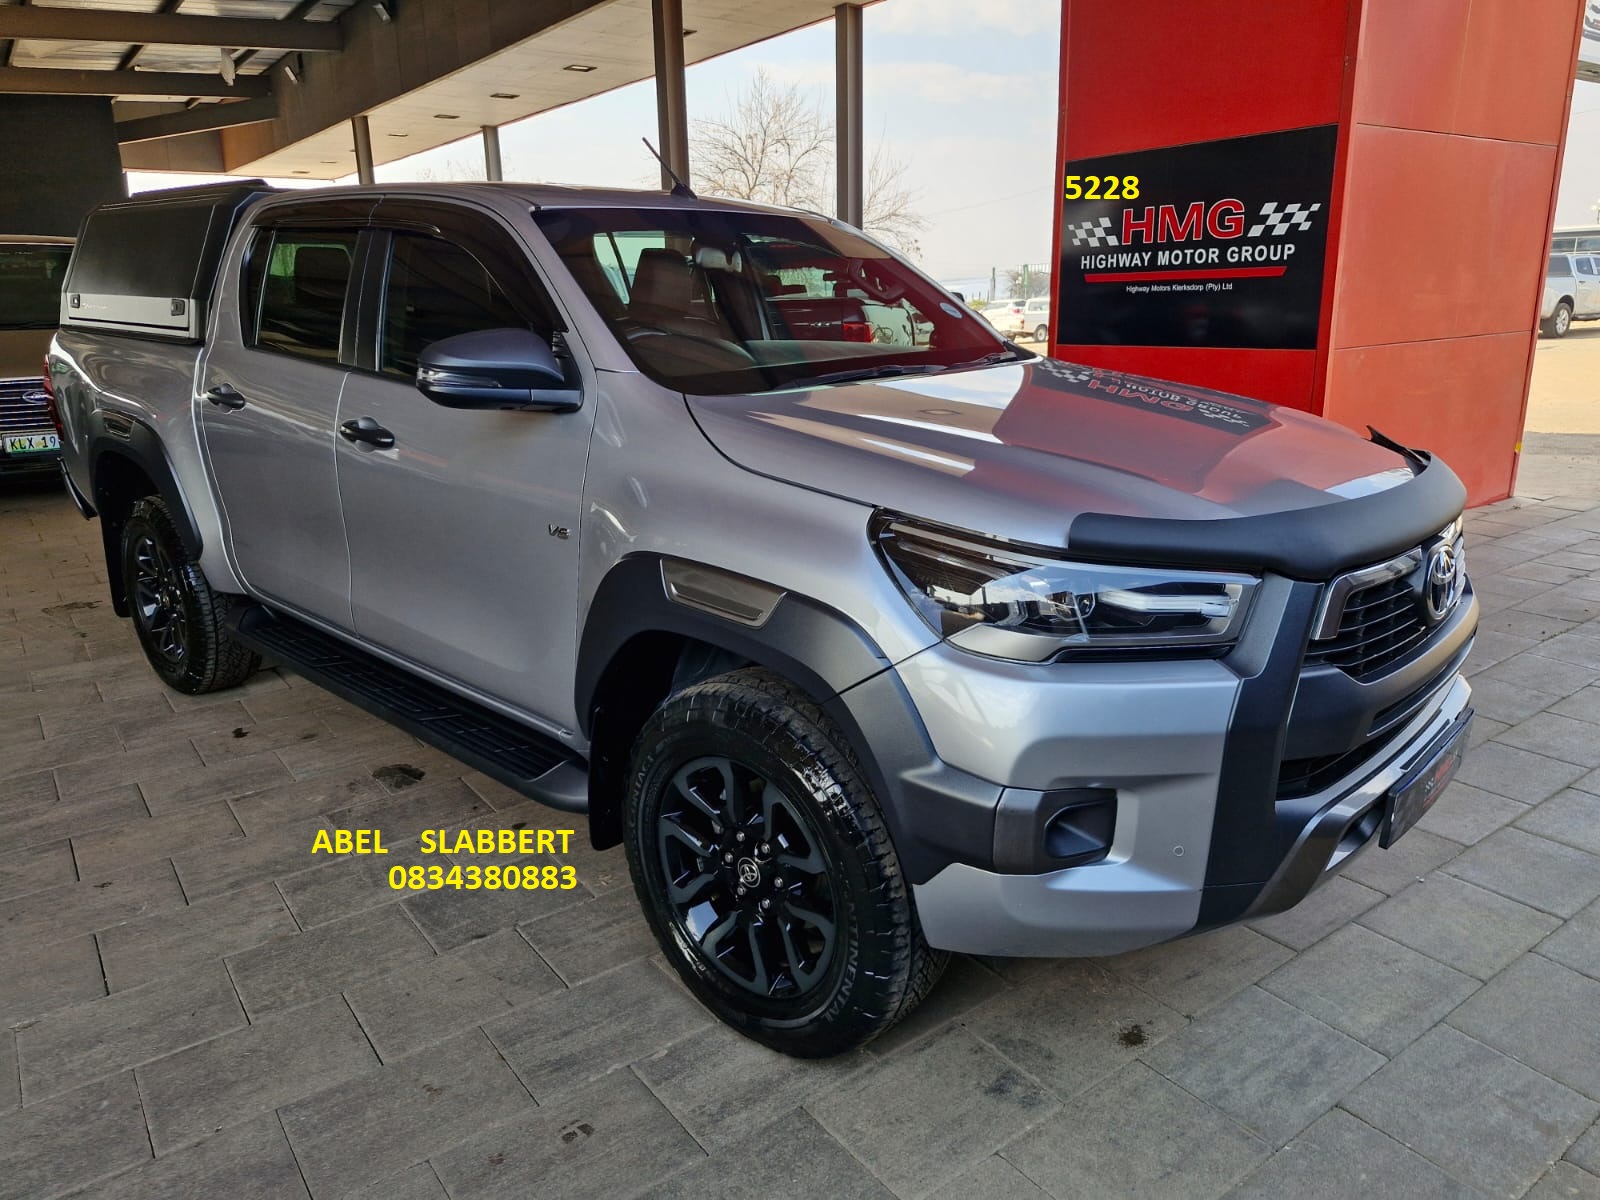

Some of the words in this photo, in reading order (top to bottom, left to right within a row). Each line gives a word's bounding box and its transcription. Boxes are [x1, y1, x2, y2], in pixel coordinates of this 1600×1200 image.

[1121, 198, 1245, 246] HMG
[1080, 251, 1152, 270] HIGHWAY
[1157, 248, 1219, 266] MOTOR
[1226, 243, 1296, 262] GROUP
[1126, 284, 1150, 293] Highway
[1151, 284, 1171, 292] Motors
[1205, 282, 1221, 292] (Pty)
[1222, 282, 1233, 290] Ltd
[9, 437, 35, 451] KLX
